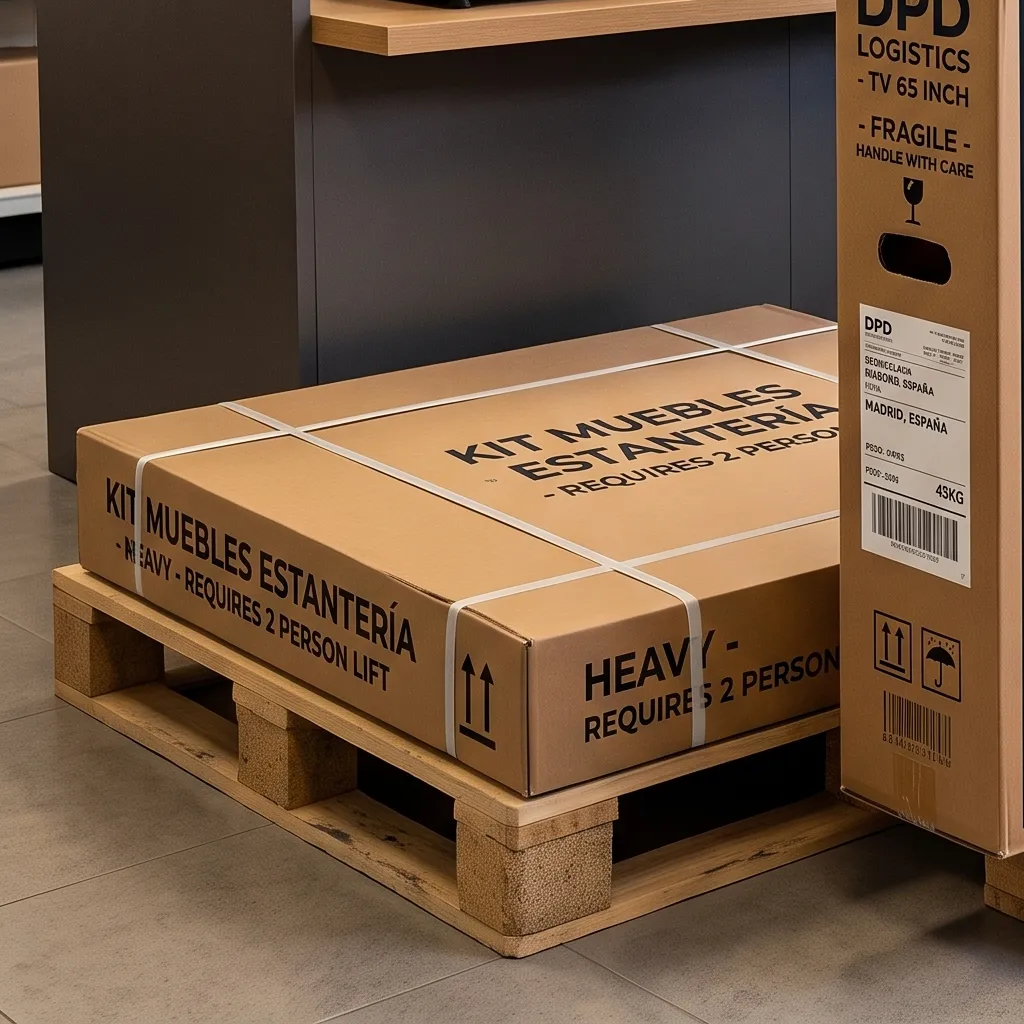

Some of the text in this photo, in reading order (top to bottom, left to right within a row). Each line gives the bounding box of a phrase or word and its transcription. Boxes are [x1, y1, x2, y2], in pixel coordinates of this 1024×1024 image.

[857, 33, 971, 74] LOGISTICS
[868, 71, 891, 94] TV
[896, 75, 918, 99] 65
[923, 80, 969, 108] INCH
[856, 142, 974, 179] HANDLE WITH CARE
[871, 115, 958, 153] FRAGILE
[864, 315, 892, 336] DPD
[445, 384, 802, 465] KIT MUEBLES
[507, 403, 839, 481] ESTANTERÍA
[865, 398, 948, 435] MADRID, ESPAÑA
[557, 456, 714, 497] REQUIRES
[711, 450, 742, 464] 2
[735, 427, 839, 457] PERSO
[106, 477, 417, 664] KIT MUEBLES ESTANTERÍA
[185, 566, 262, 627] REQUIRES
[265, 608, 276, 635] 2
[279, 613, 348, 673] PERSON
[353, 650, 391, 692] LIFT
[584, 645, 840, 744] REQUIRES 2 PERSON
[585, 629, 716, 702] HEAVY
